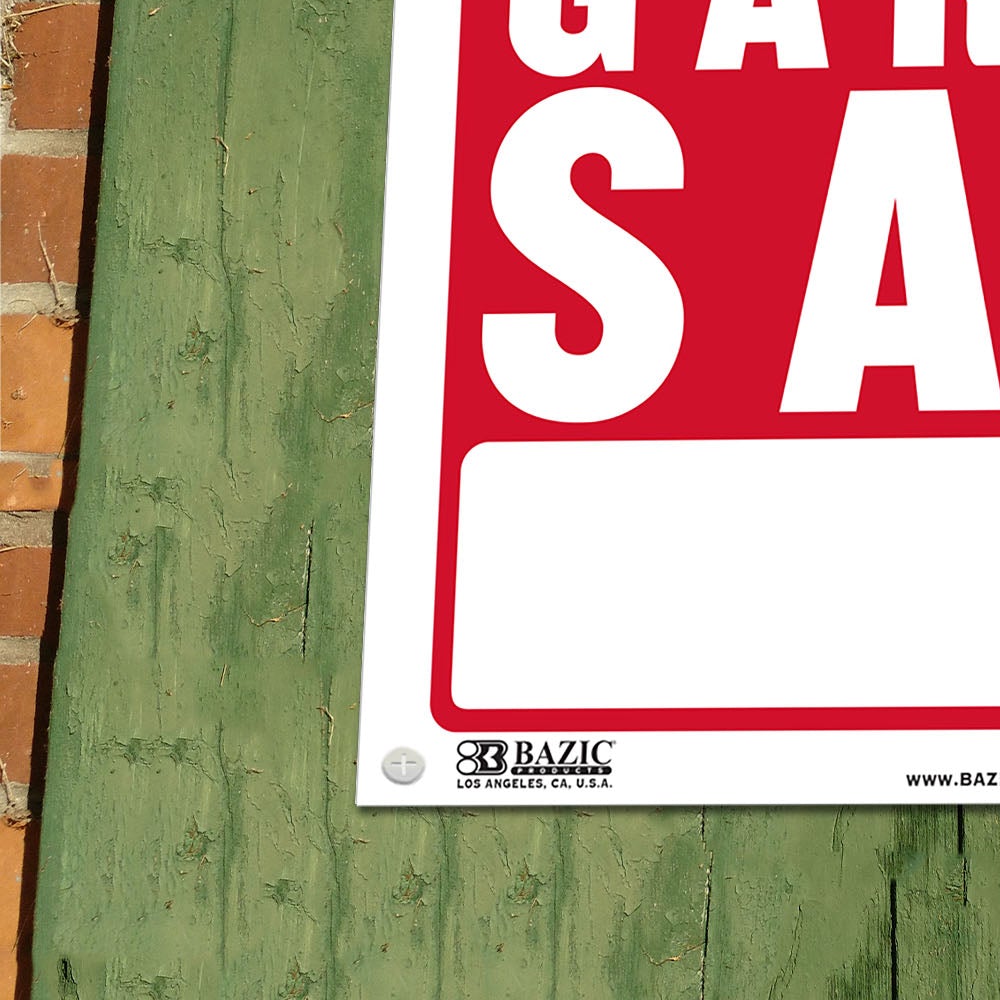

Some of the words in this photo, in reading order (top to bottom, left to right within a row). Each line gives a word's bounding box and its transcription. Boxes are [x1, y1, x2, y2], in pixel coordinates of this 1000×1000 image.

[514, 740, 613, 765] BAZIC
[516, 767, 604, 775] PRODUCTS
[457, 778, 481, 789] LOS
[485, 778, 547, 790] ANGELES,
[551, 778, 572, 790] CA,
[576, 778, 613, 789] U.S.A.
